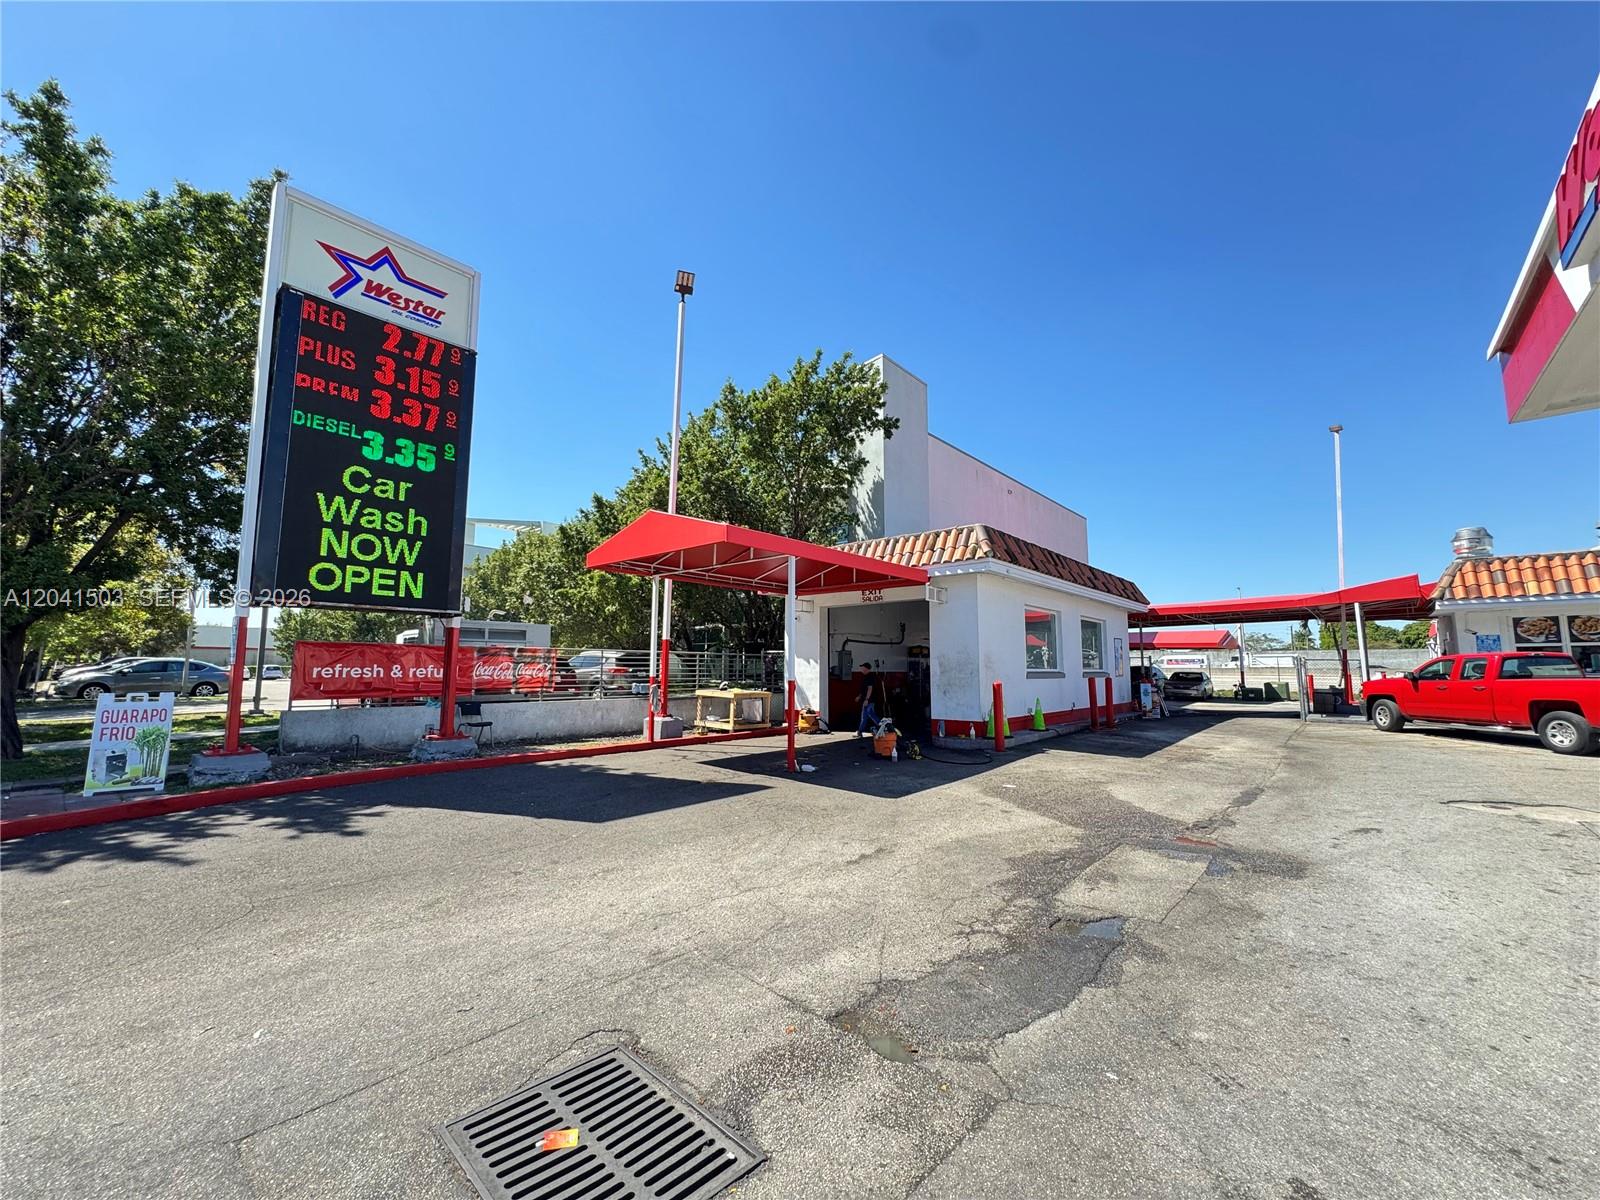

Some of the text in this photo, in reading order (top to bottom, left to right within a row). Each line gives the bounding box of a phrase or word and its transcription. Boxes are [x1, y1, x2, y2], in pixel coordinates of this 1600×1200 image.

[364, 279, 446, 319] Westar
[302, 300, 346, 331] REG
[383, 323, 445, 366] 2.77
[405, 314, 440, 329] COMPANY
[299, 336, 356, 370] PLUS
[375, 355, 441, 398] 3.15
[369, 389, 440, 432] 3.37
[292, 409, 362, 439] DIESEL
[362, 430, 437, 472] 3.35
[342, 465, 413, 501] Car
[316, 492, 428, 536] Wash
[320, 528, 423, 566] NOW
[308, 562, 424, 599] OPEN
[312, 663, 444, 679] refresh & refu
[99, 724, 136, 742] FRÍO
[100, 707, 168, 724] GUARAPO
